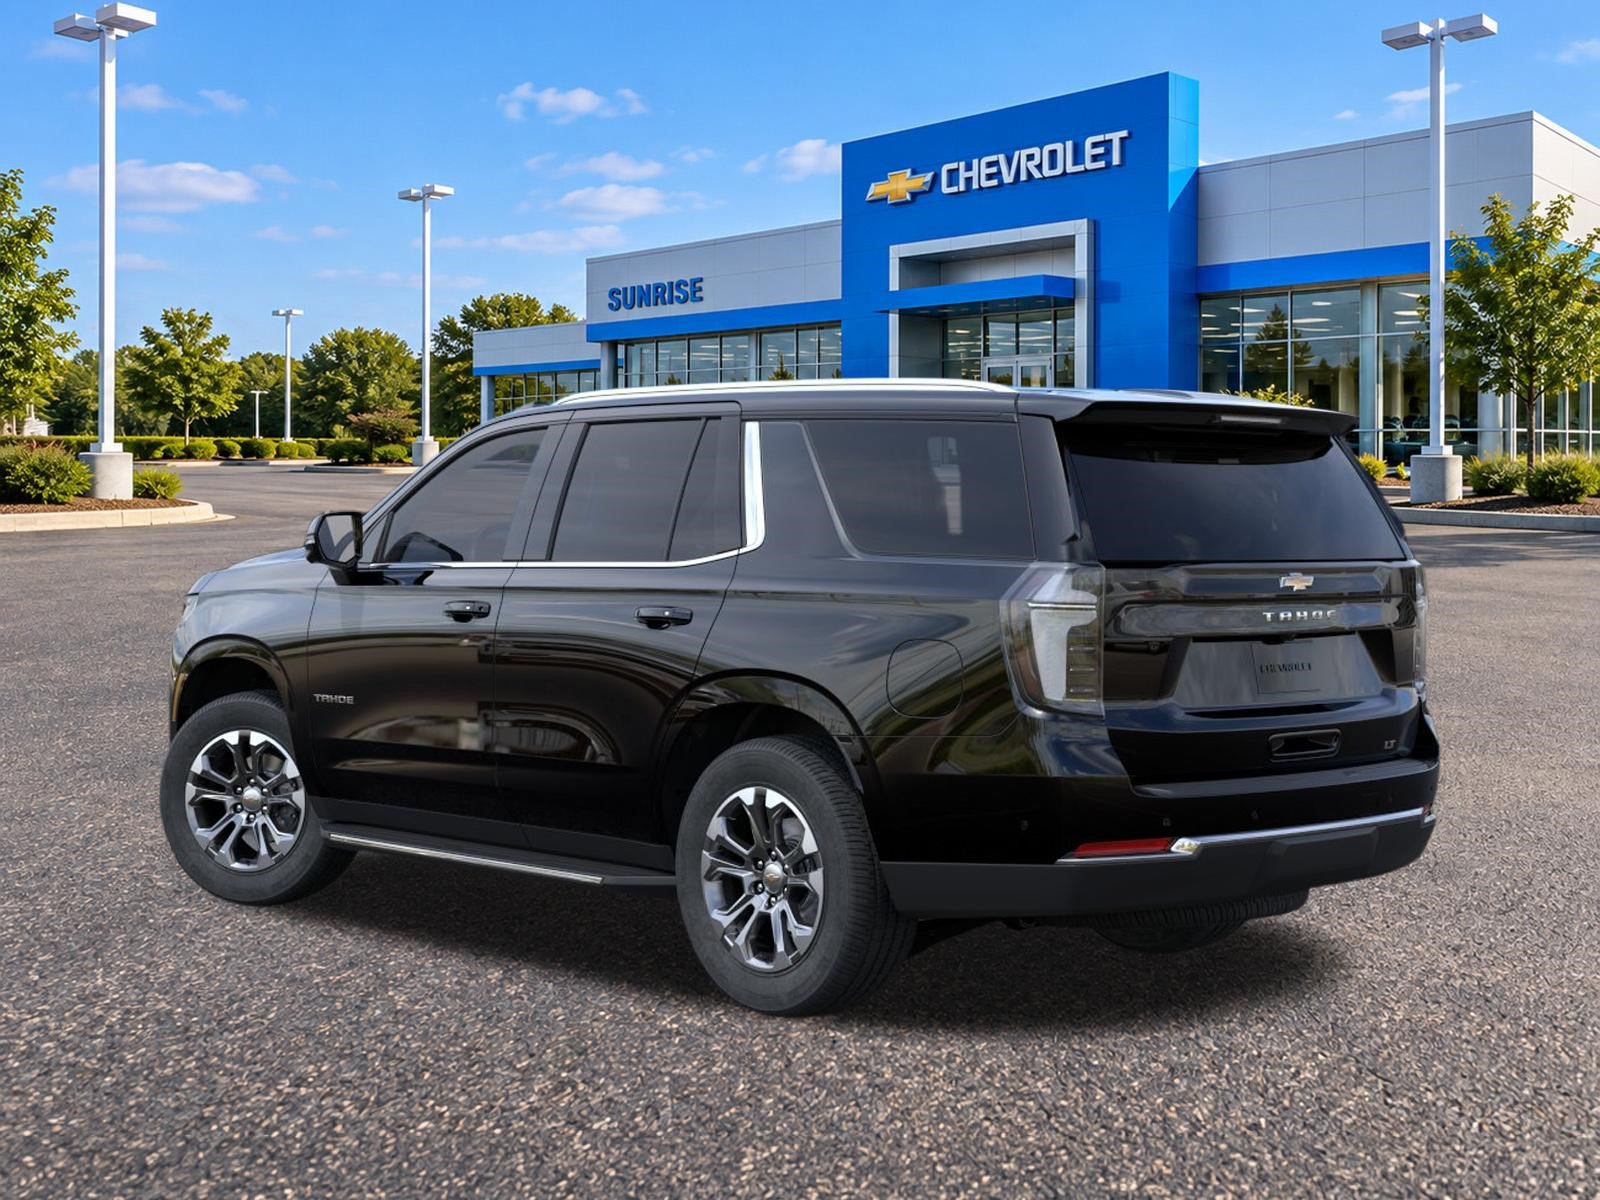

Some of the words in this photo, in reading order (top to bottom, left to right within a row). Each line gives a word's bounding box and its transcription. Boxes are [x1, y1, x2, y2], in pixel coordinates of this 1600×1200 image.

[941, 130, 1129, 194] CHEVROLET
[607, 277, 704, 312] SUNRISE
[312, 693, 354, 705] TAHOE
[1384, 739, 1397, 750] LT
